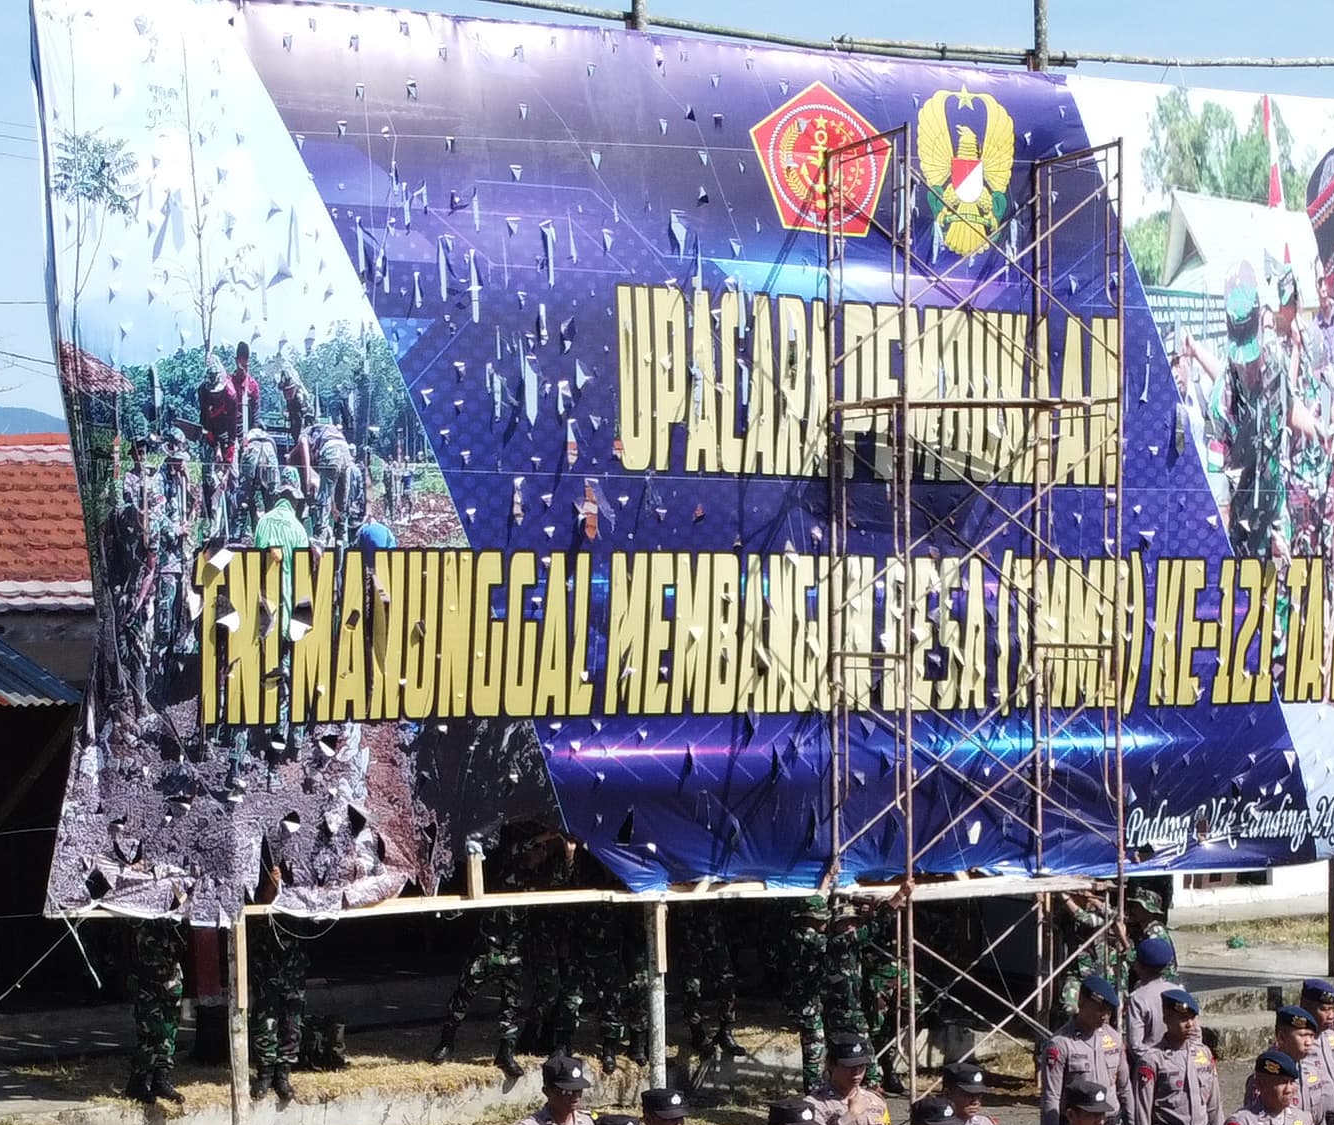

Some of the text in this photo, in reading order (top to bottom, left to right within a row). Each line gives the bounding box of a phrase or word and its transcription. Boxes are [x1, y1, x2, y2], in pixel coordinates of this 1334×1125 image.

[616, 284, 831, 481] UPACARA
[194, 549, 282, 726] TNI
[290, 549, 594, 724] MANUNGGAL
[602, 551, 875, 717] MEMBANGUN
[880, 555, 987, 714] DESA
[1148, 556, 1277, 707] KE-121
[1281, 555, 1324, 703] TA
[1126, 799, 1190, 856] Padang
